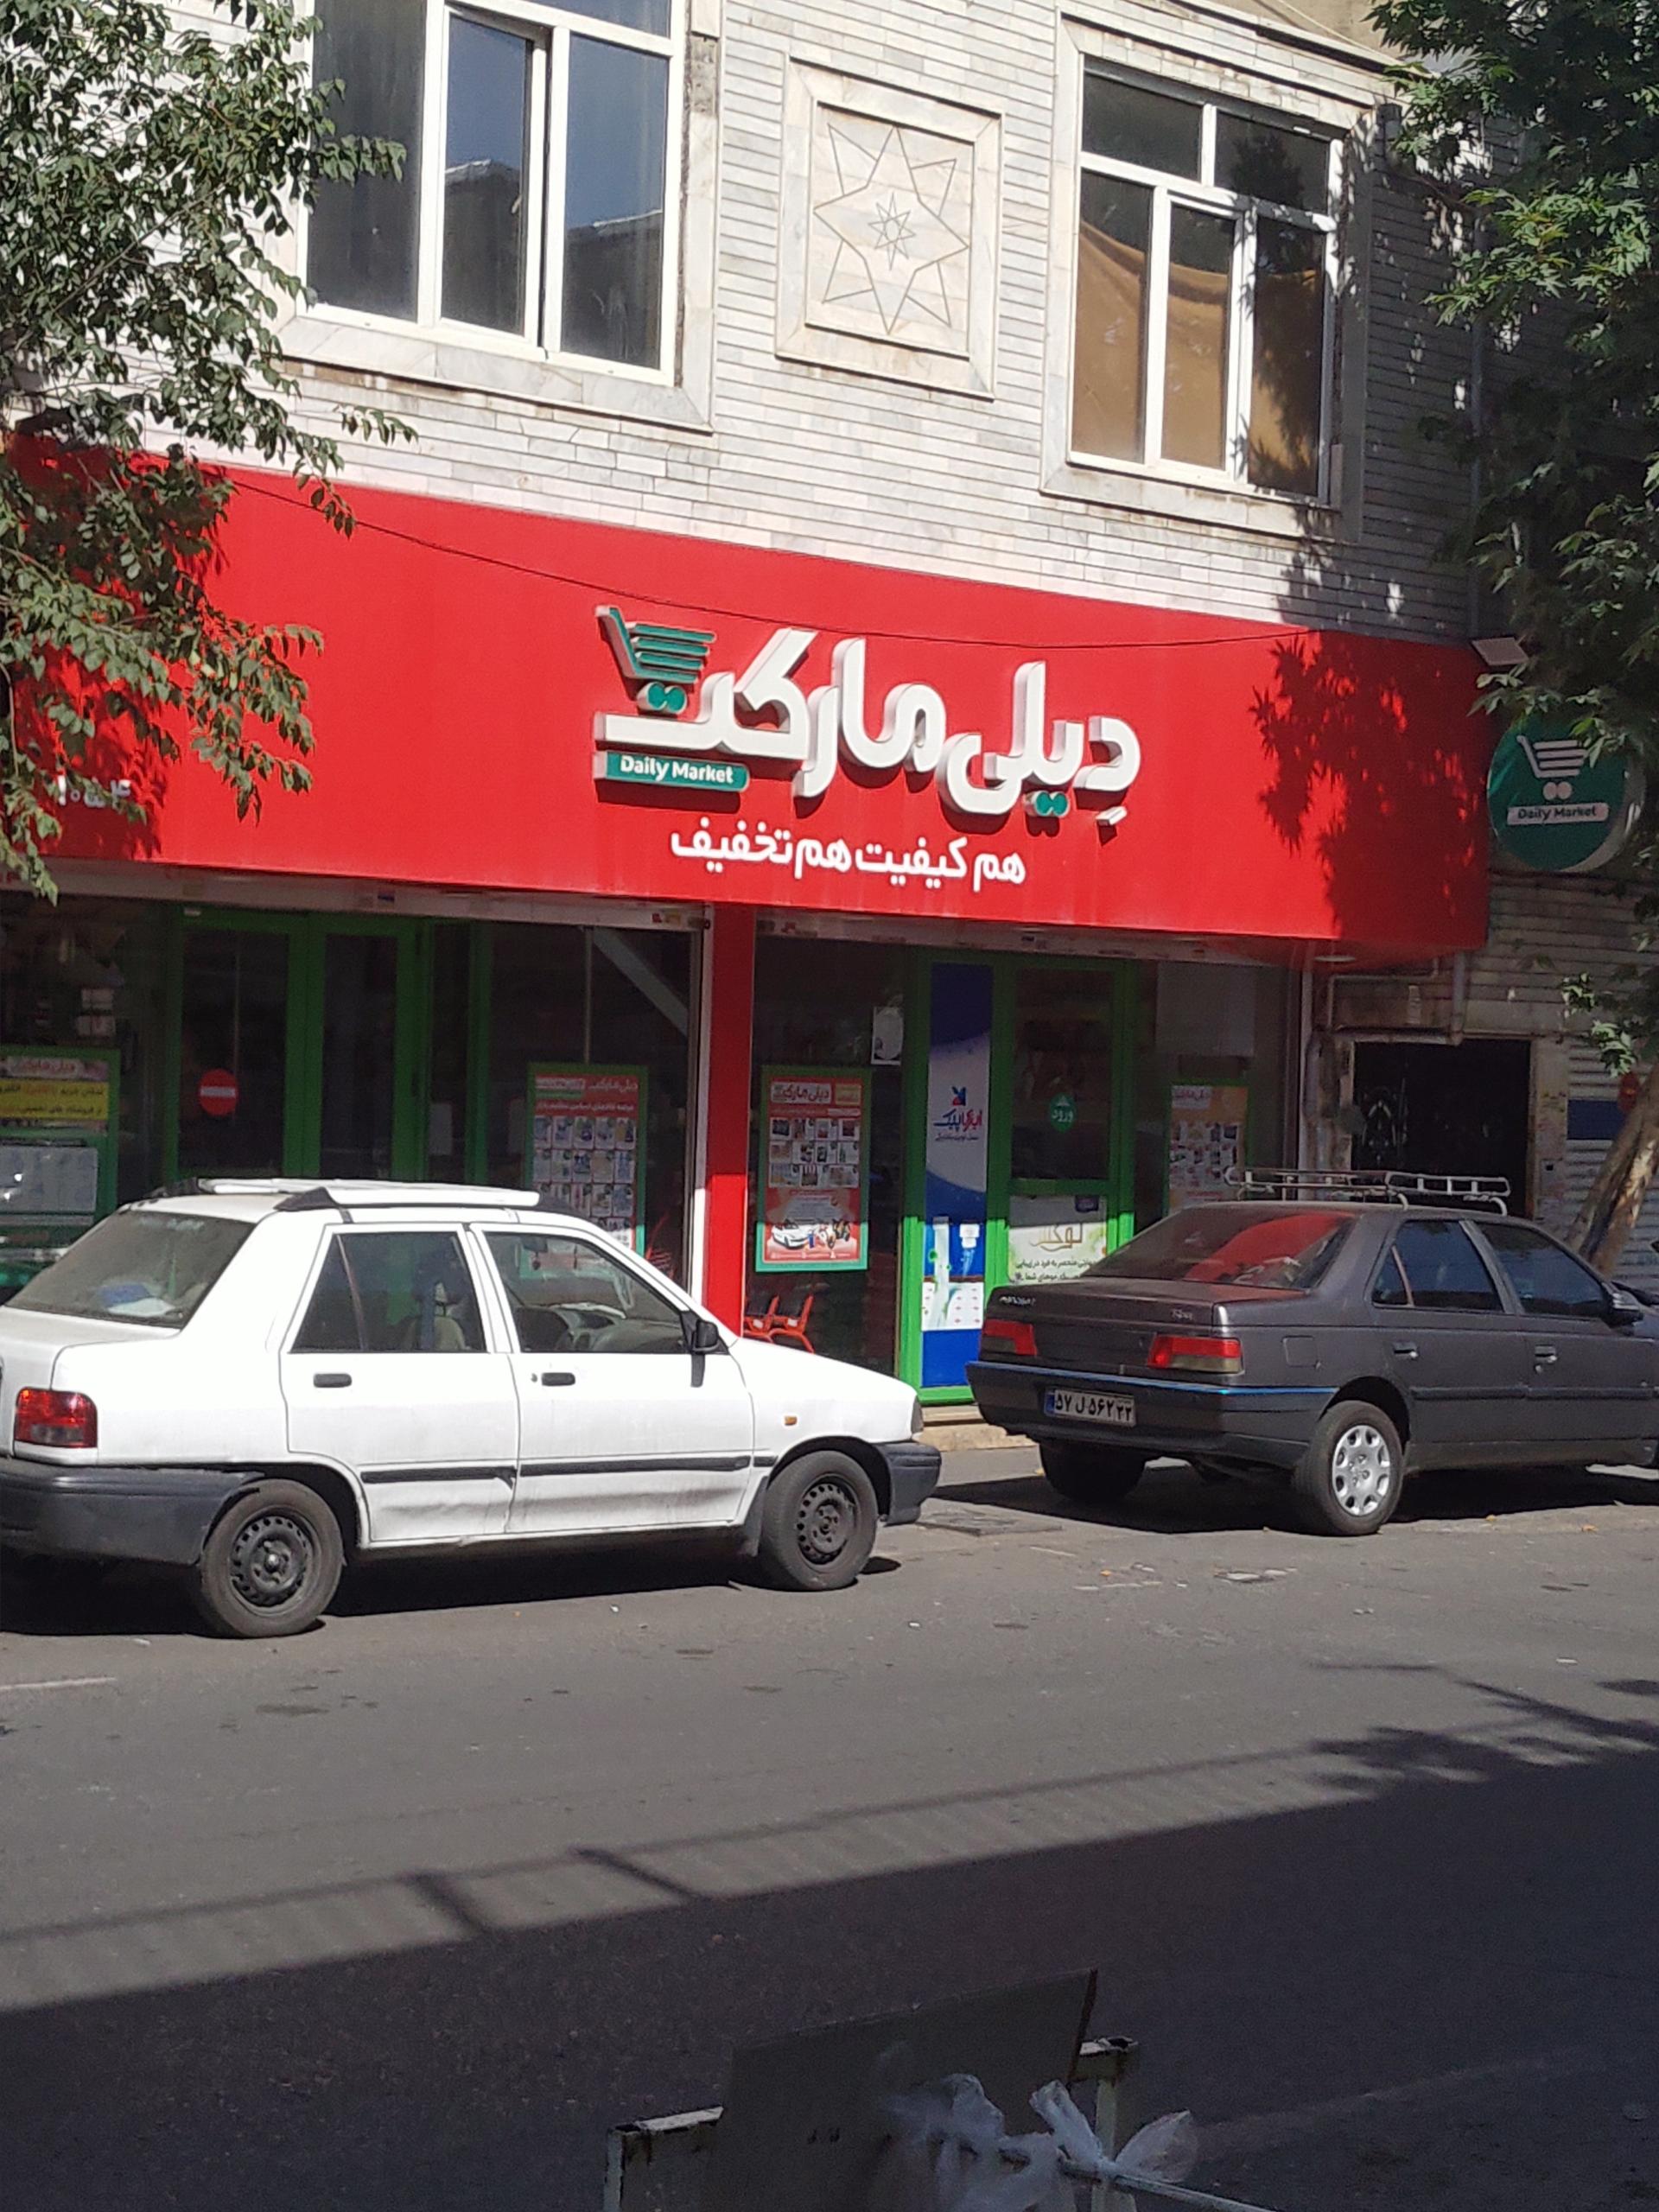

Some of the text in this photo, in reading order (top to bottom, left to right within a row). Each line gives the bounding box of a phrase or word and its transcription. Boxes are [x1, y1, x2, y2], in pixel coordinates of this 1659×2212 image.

[593, 627, 948, 798] مارکت
[620, 755, 734, 785] Daily Market
[1517, 804, 1597, 820] Daily Market
[671, 817, 1027, 893] هم کیفیت هم تخفیف
[1051, 1109, 1073, 1122] ورود
